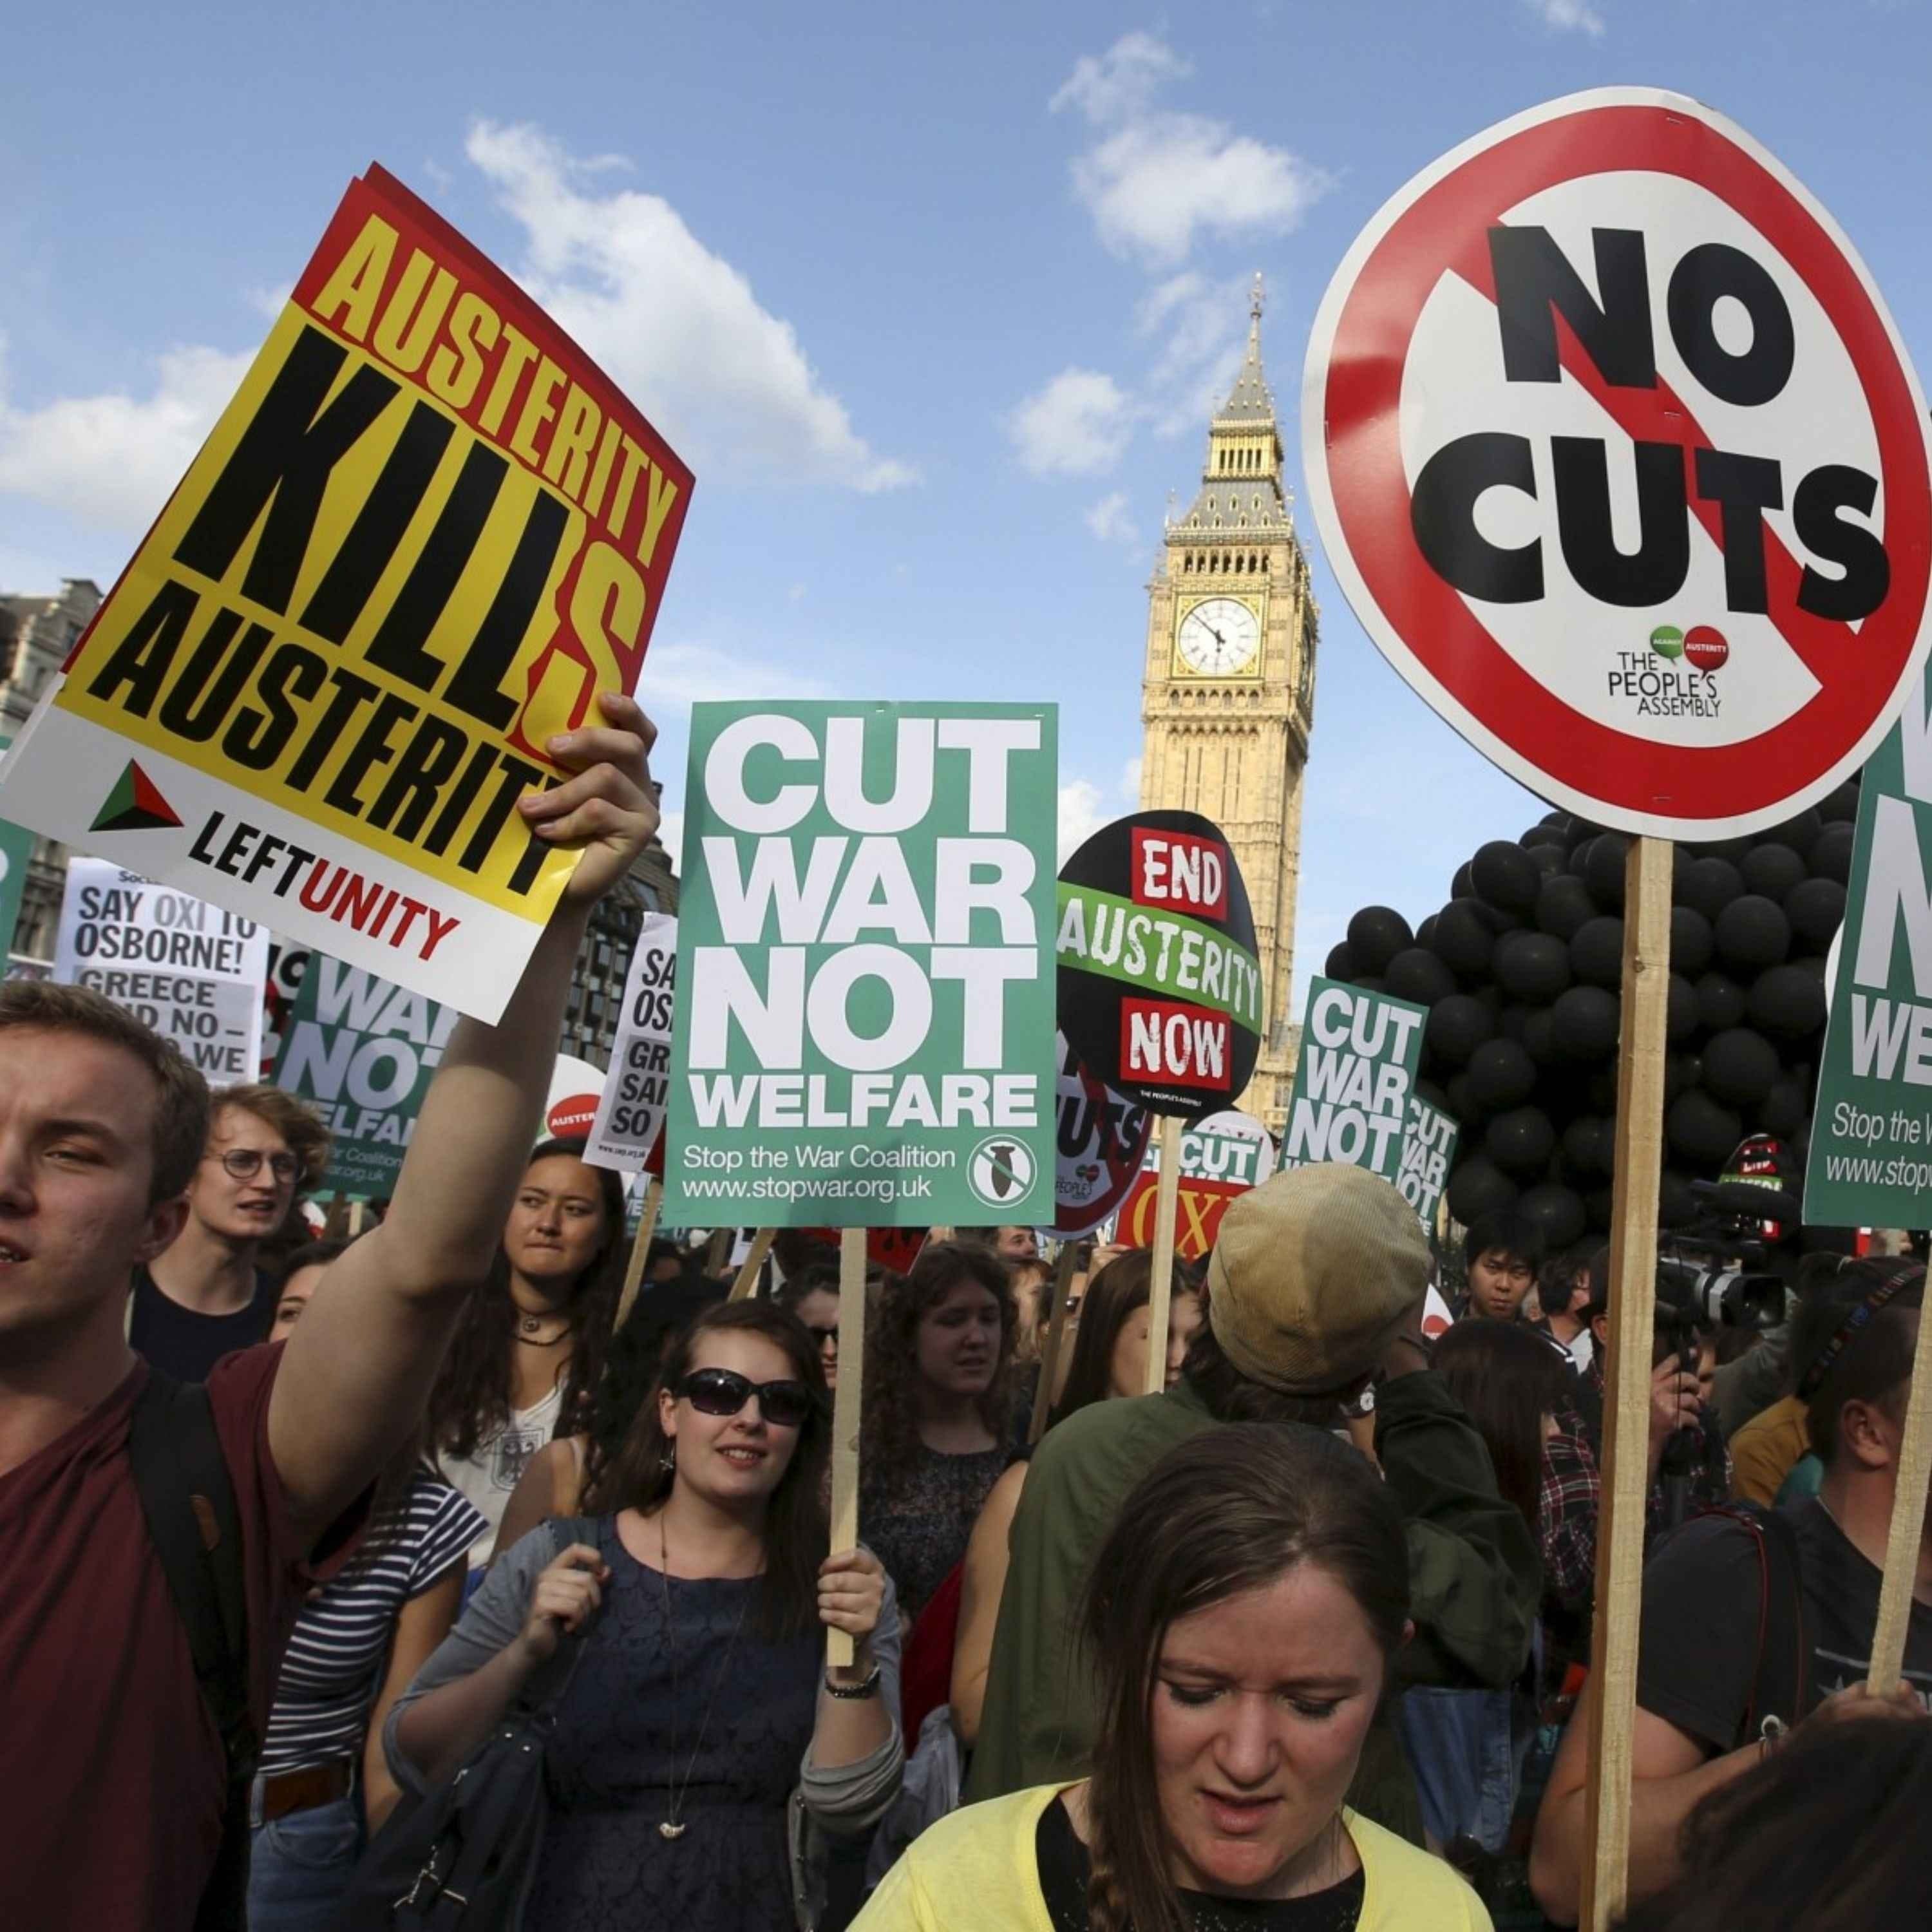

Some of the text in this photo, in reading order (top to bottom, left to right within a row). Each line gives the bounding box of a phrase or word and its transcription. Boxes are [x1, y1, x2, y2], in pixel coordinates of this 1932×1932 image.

[1486, 225, 1795, 408] NO
[310, 214, 678, 567] AUSTERITY
[172, 324, 646, 763] KILLS
[1410, 431, 1891, 622] CUTS
[1608, 671, 1718, 699] PEOPLE'S
[1616, 652, 1658, 670] THE
[1637, 697, 1721, 717] ASSEMBLY
[705, 714, 1041, 834] CUT
[701, 837, 1037, 945] WAR
[1141, 838, 1222, 905] END
[78, 886, 144, 922] SAY
[154, 894, 206, 931] OXI
[73, 922, 244, 974] OSBORNE!
[1056, 898, 1260, 1021] AUSTERITY
[78, 970, 216, 1009] GREECE
[688, 943, 1037, 1072] NOT
[171, 1008, 218, 1039] NO
[1128, 1012, 1225, 1079] NOW
[1311, 988, 1423, 1066] CUT
[193, 1041, 246, 1074] WE
[1306, 1044, 1408, 1119] WAR
[611, 1105, 651, 1137] SO
[687, 1074, 1037, 1129] WELFARE
[1831, 1102, 1884, 1147] Stop
[1889, 1109, 1921, 1144] the
[683, 1144, 956, 1173] Stop the War Coalition
[1180, 1134, 1256, 1177] CUT
[1285, 1097, 1403, 1173] NOT
[682, 1175, 933, 1204] www.stopwar.org.uk
